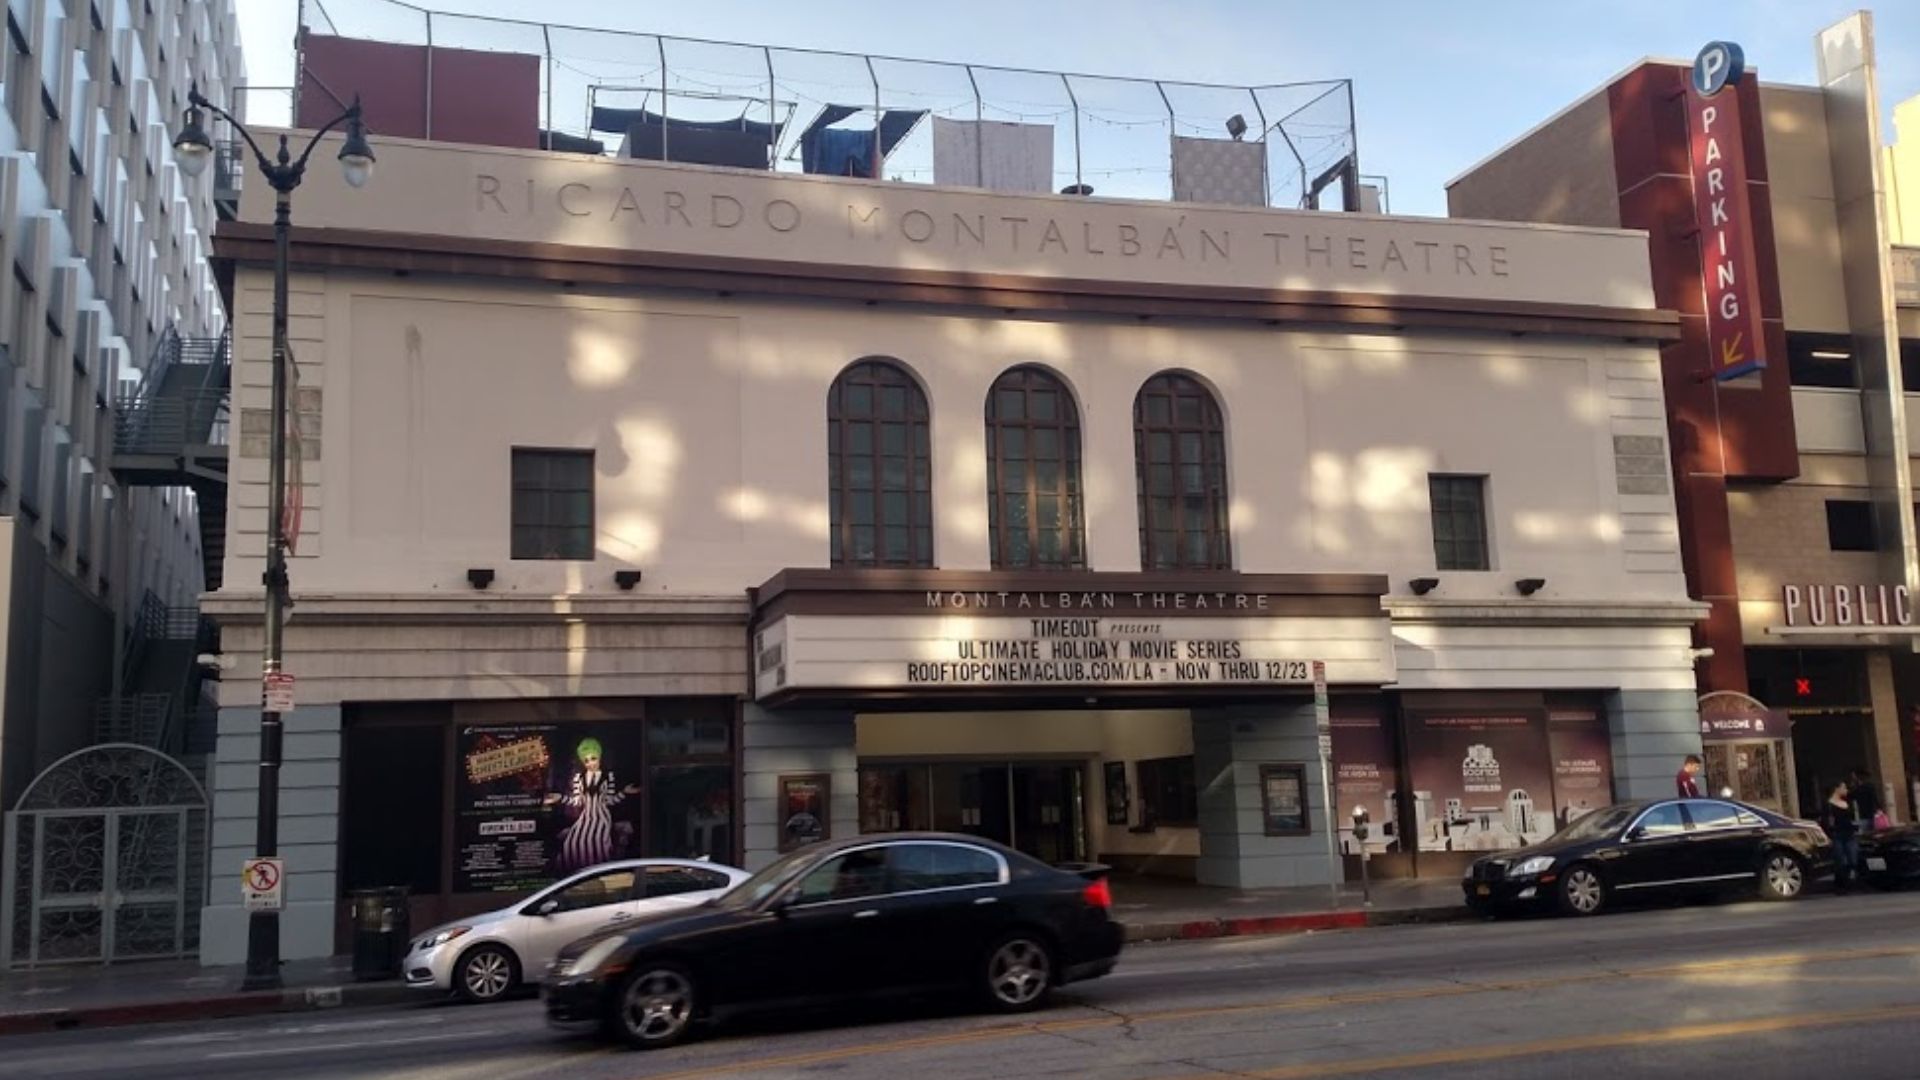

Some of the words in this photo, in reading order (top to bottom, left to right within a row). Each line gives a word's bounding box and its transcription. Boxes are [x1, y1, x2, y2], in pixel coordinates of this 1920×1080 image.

[1702, 49, 1724, 90] P
[1702, 105, 1739, 320] PARKING
[476, 174, 801, 233] RICARDO
[847, 204, 1230, 263] MONTALBÁN
[1263, 232, 1510, 277] THEATRE
[926, 591, 1115, 609] MONTALBÁN
[1132, 592, 1269, 610] THEATRE
[1784, 584, 1912, 626] PUBLIC
[1030, 618, 1100, 638] TIMEOUT
[1110, 624, 1162, 634] PRESENTS
[958, 640, 1040, 660] ULTIMATE
[1051, 640, 1120, 660] HOLIDAY
[1130, 640, 1179, 660] MOVIE
[1187, 640, 1241, 660] SERIES
[907, 661, 1154, 682] ROOFTOPCINEMACLUB.COM/LA
[1175, 661, 1210, 681] NOW
[1218, 661, 1260, 681] THRU
[1266, 661, 1308, 680] 12/23
[1712, 718, 1751, 730] WELCOME
